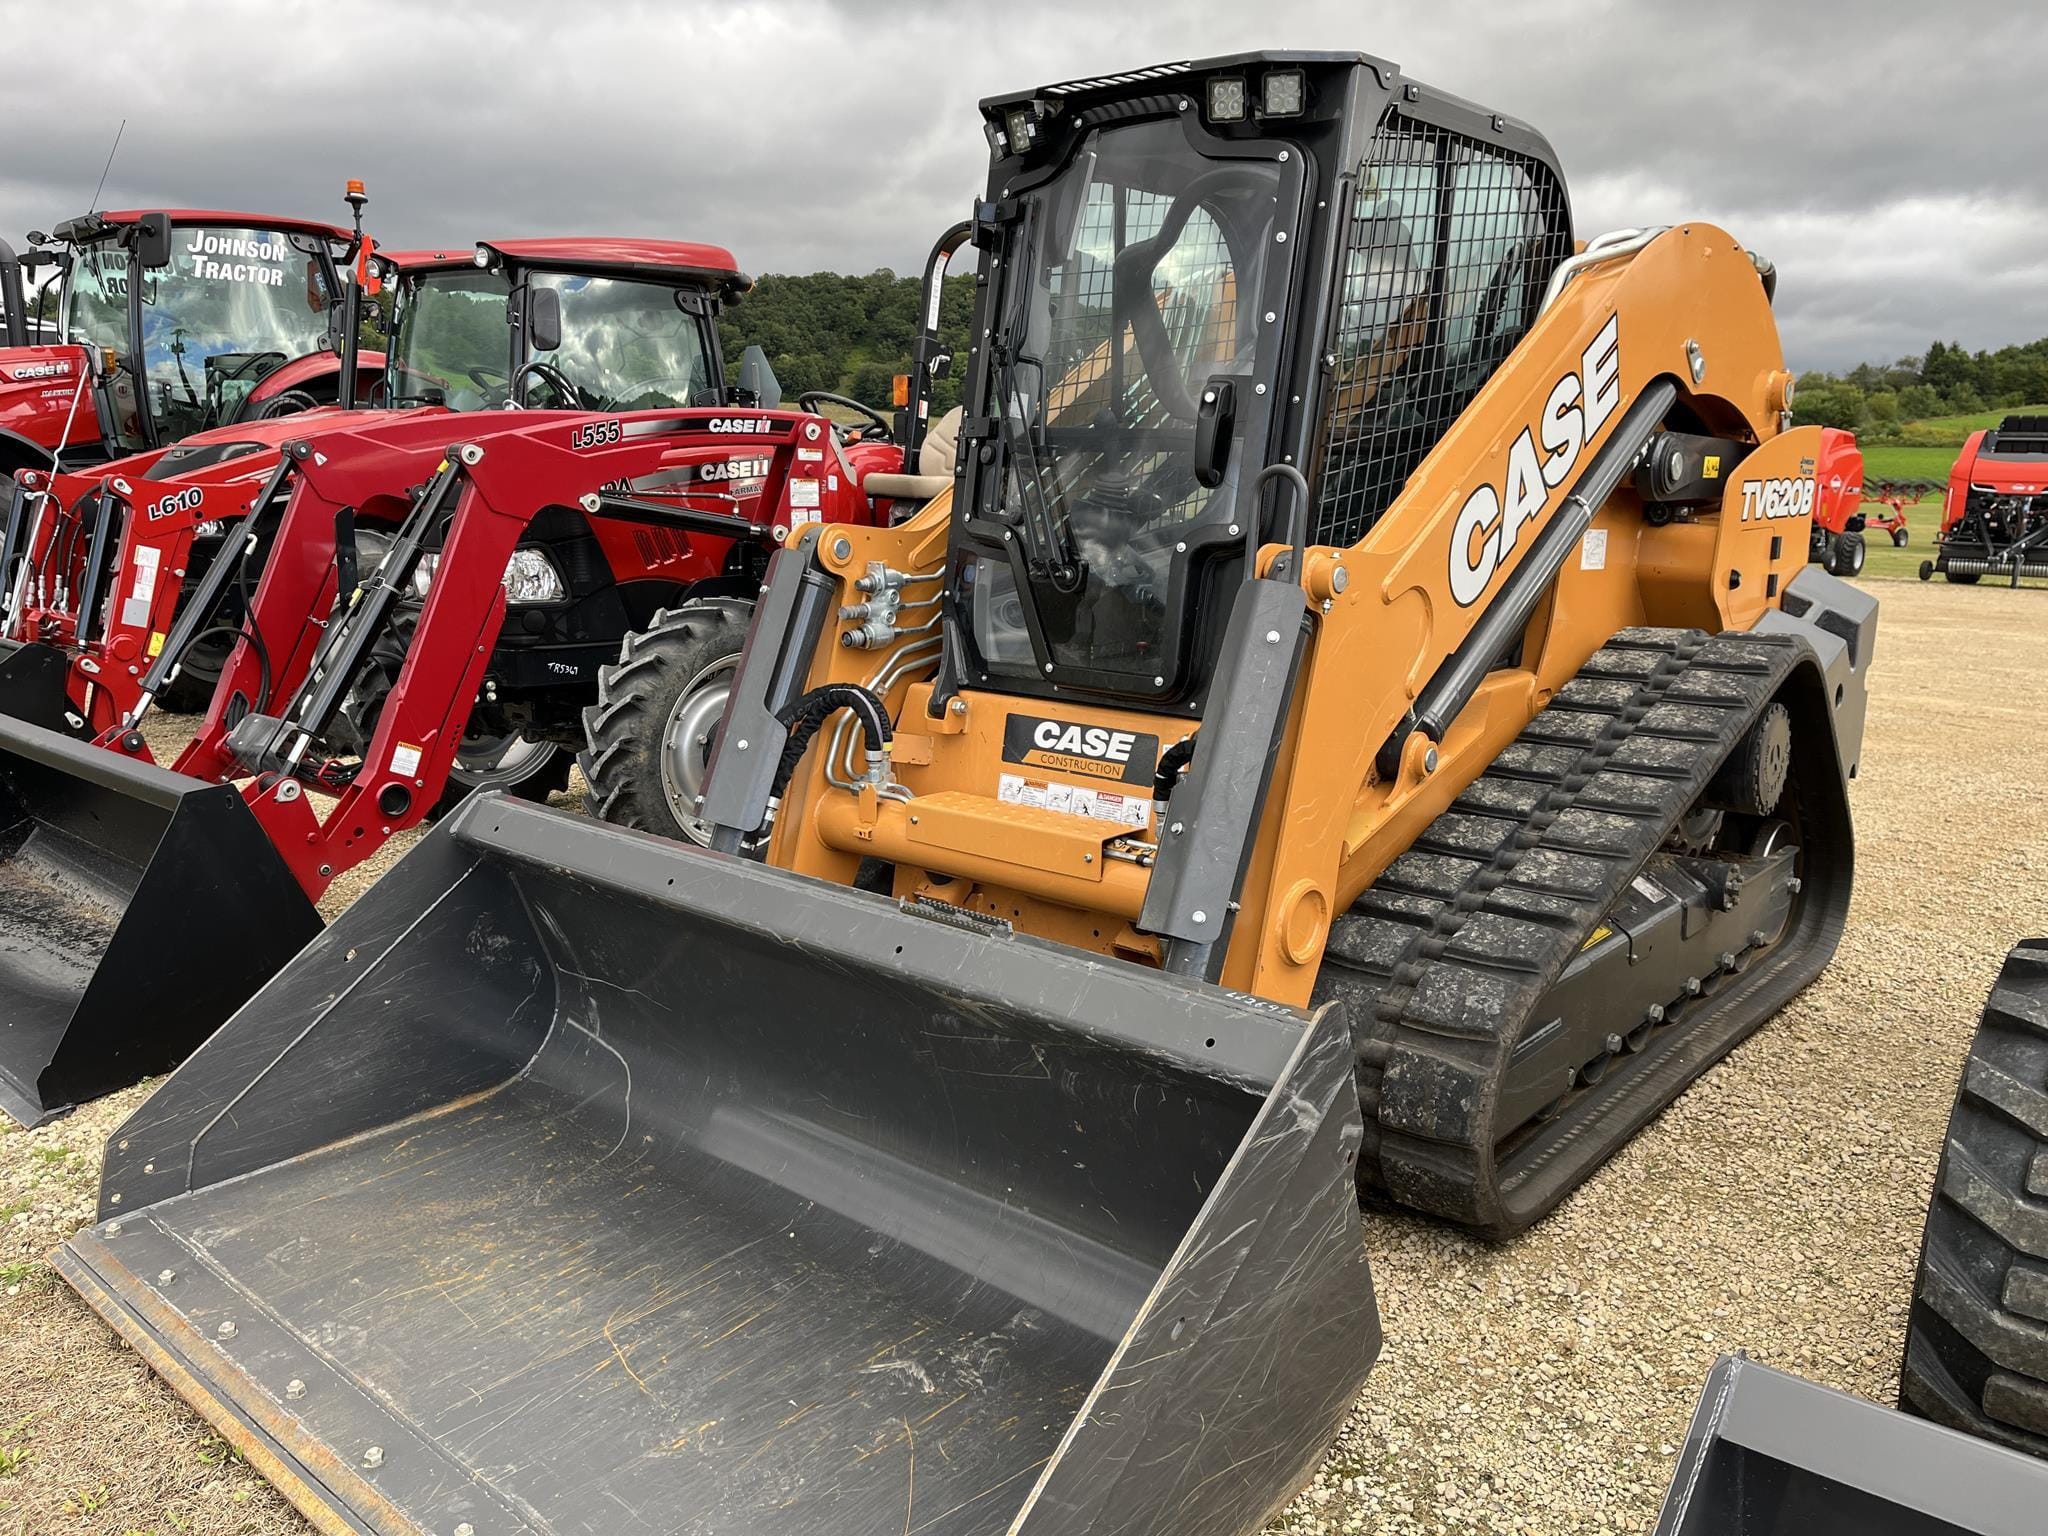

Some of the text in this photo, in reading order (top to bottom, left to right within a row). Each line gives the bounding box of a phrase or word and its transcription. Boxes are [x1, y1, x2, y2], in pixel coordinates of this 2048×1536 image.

[187, 230, 286, 263] JOHNSON
[191, 255, 284, 287] TRACTOR
[14, 365, 55, 379] CASE
[571, 419, 622, 451] L555
[708, 417, 756, 434] CASE
[700, 460, 752, 482] CASE
[1449, 311, 1620, 607] CASE
[147, 486, 204, 522] L610
[1741, 478, 1816, 522] TV620B
[1033, 721, 1136, 762] CASE
[1040, 753, 1121, 777] CONSTRUCTION
